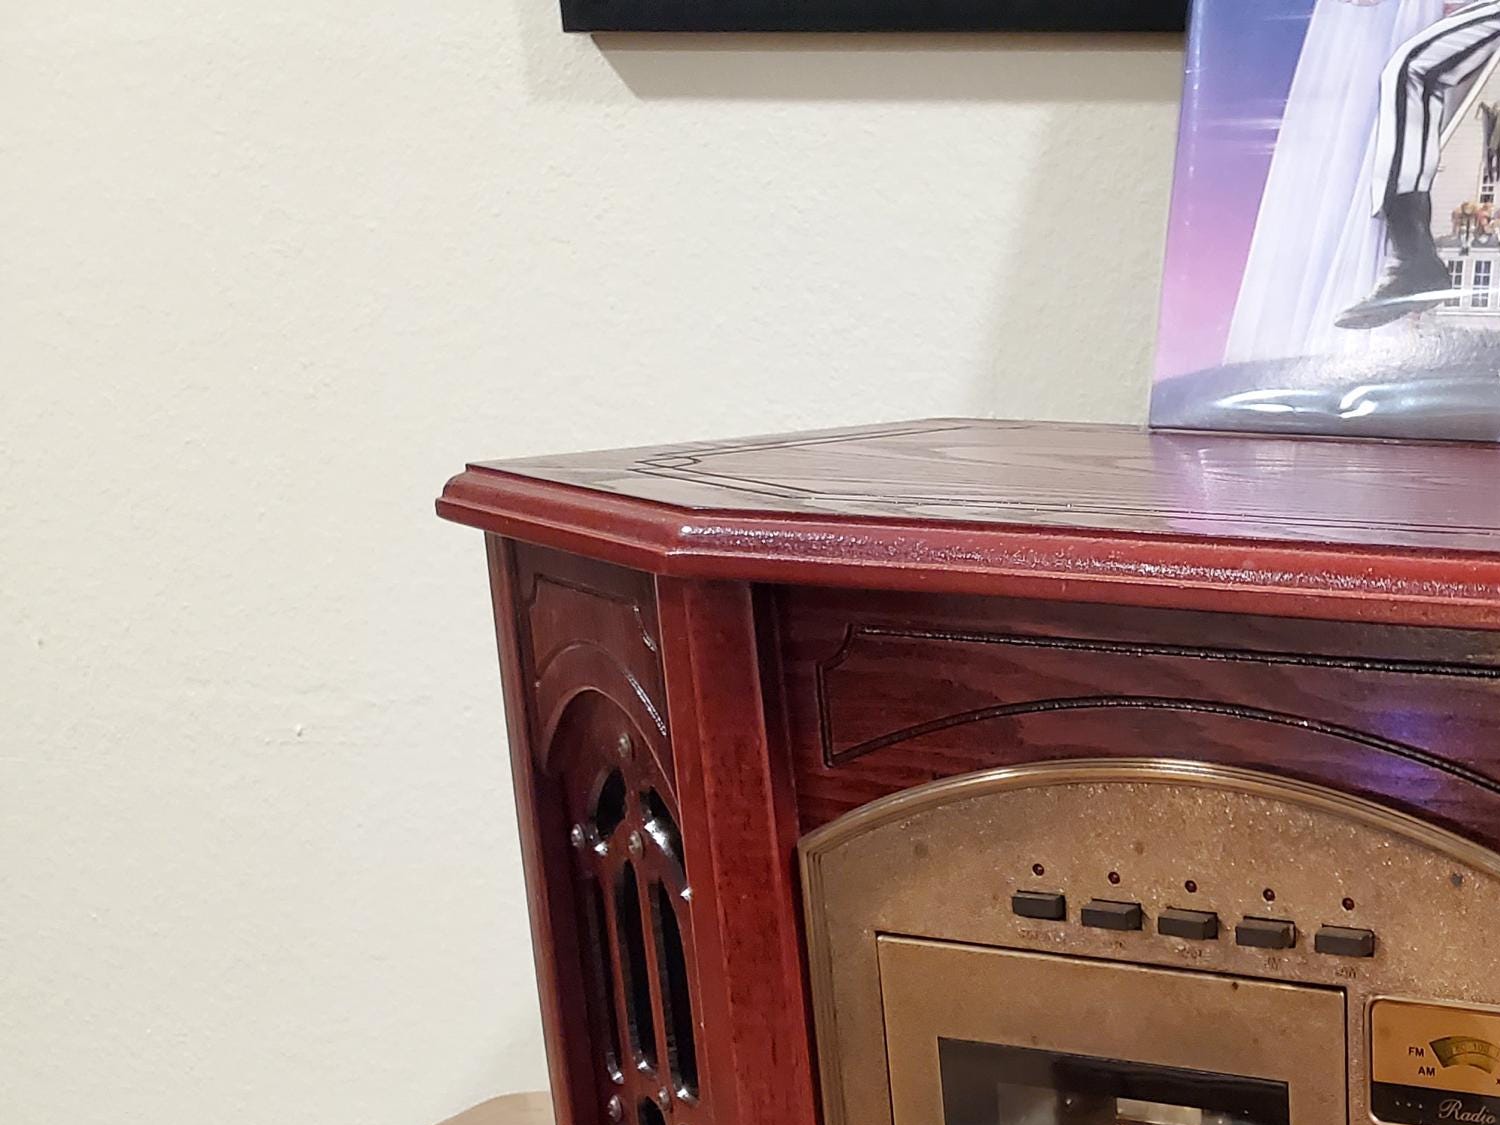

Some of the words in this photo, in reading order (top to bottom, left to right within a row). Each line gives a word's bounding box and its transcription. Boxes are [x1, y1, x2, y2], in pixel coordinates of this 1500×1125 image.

[1408, 1046, 1425, 1058] FM
[1417, 1065, 1436, 1077] AM
[1437, 1099, 1497, 1125] Radio
